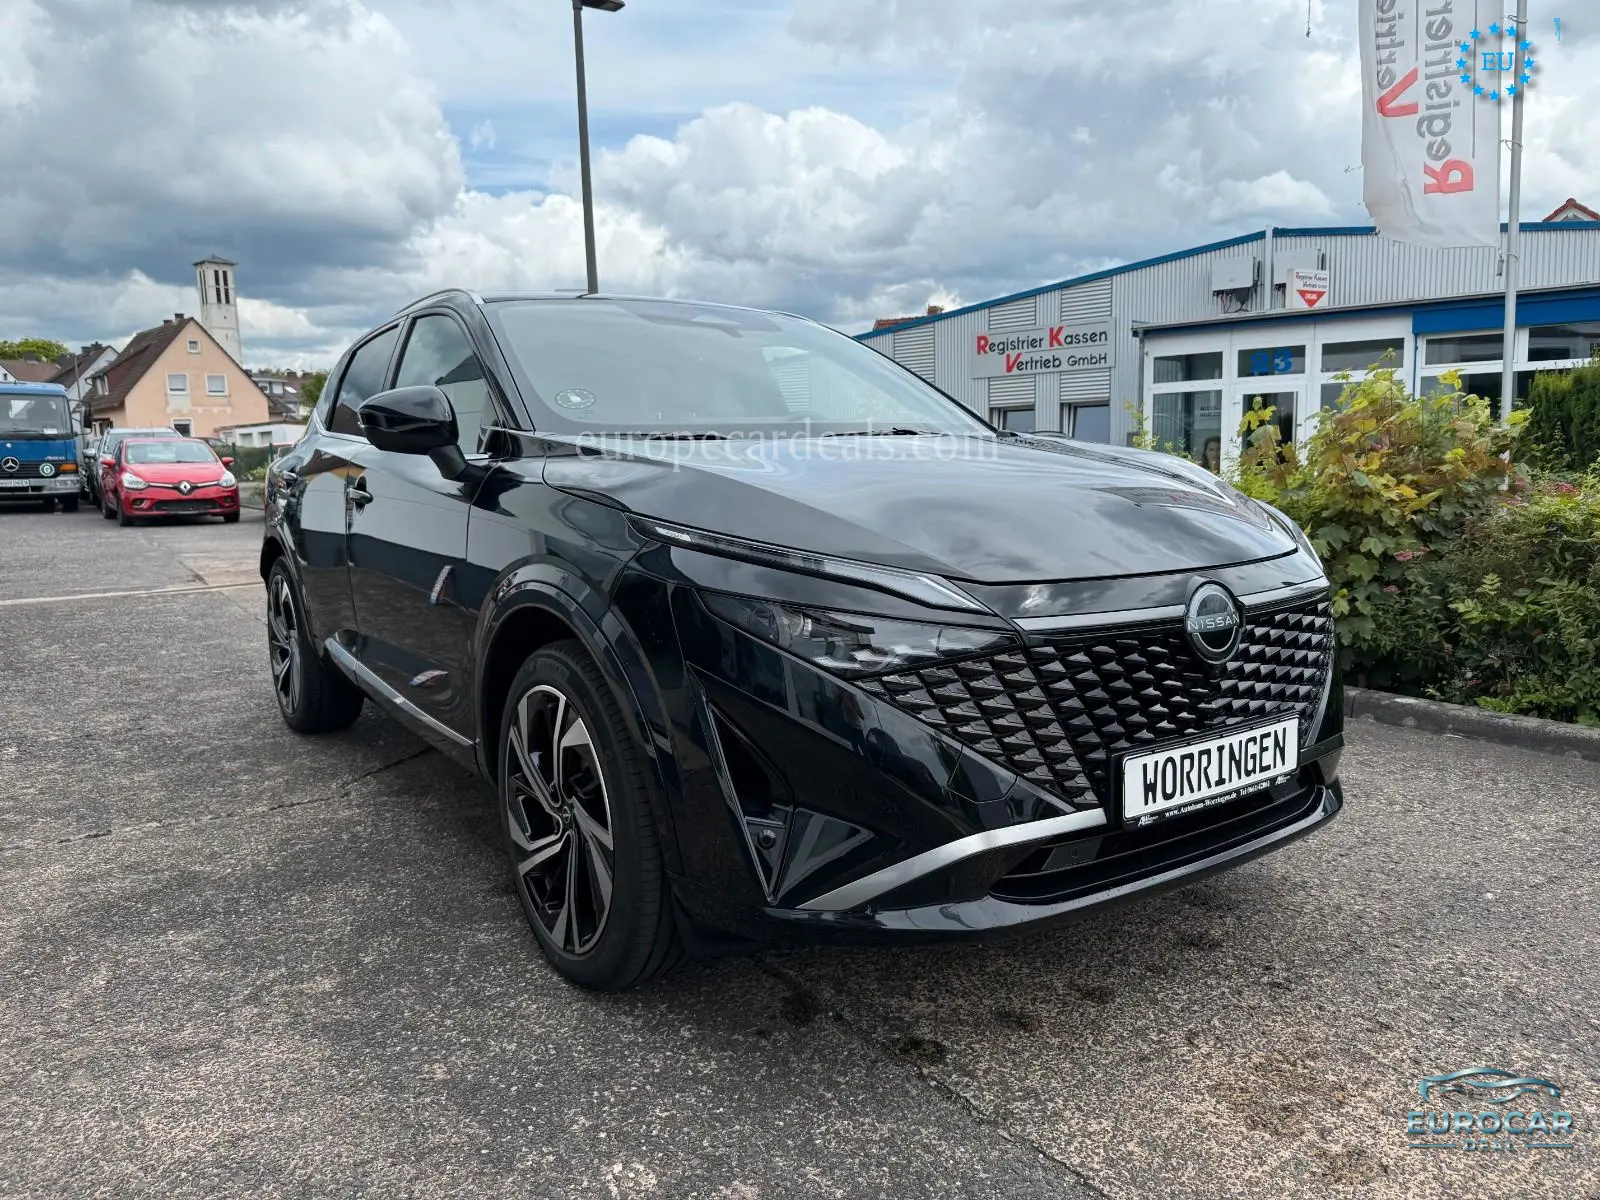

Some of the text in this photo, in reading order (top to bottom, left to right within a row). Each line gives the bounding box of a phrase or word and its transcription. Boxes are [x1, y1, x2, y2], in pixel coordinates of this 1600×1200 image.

[976, 325, 1109, 356] Registrier Kassen
[1005, 352, 1108, 374] Vertrieb GmbH
[1187, 613, 1240, 631] NISSAN
[1142, 726, 1288, 807] WORRINGEN
